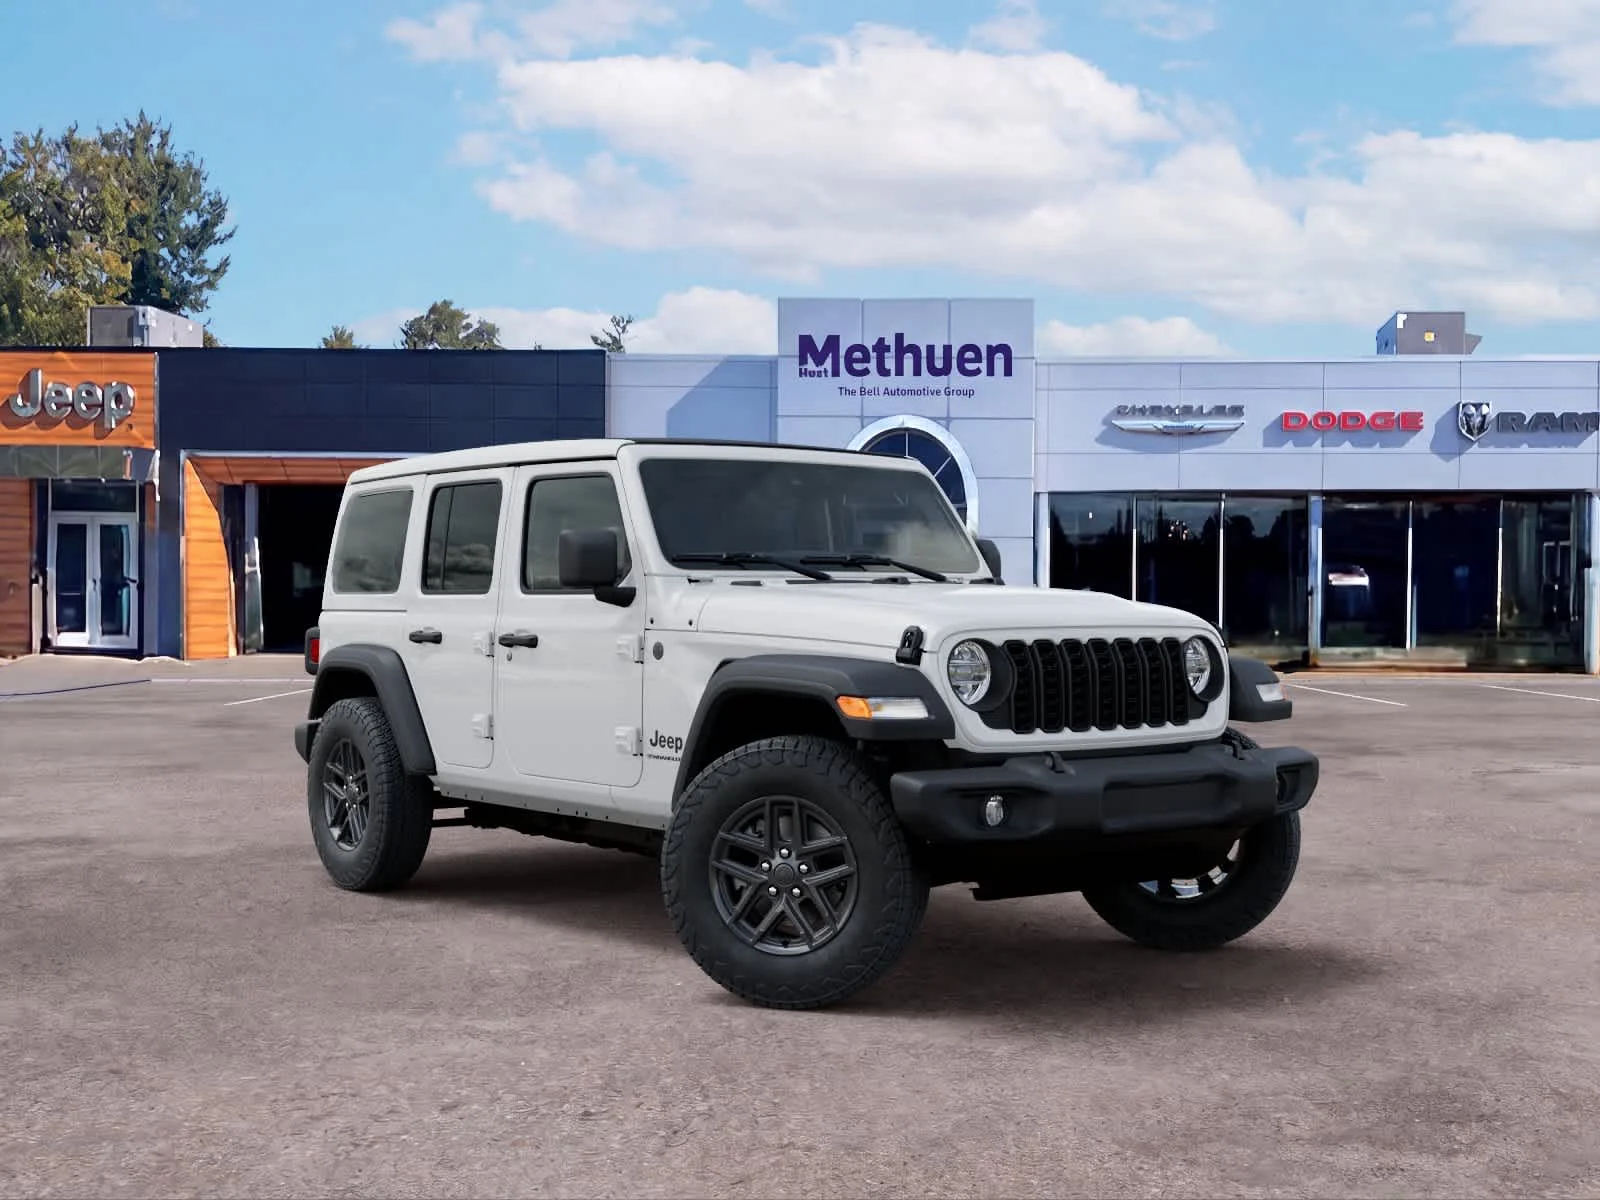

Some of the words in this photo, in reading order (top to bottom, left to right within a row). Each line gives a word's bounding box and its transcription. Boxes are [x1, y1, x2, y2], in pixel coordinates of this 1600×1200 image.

[798, 332, 1013, 378] Methuen
[9, 367, 136, 430] Jeep
[838, 386, 857, 397] The
[859, 386, 881, 397] Bell
[883, 386, 942, 397] Automotive
[944, 386, 976, 399] Group
[1282, 411, 1425, 431] DODGE
[1497, 411, 1599, 433] RAM
[649, 730, 683, 753] Jeep
